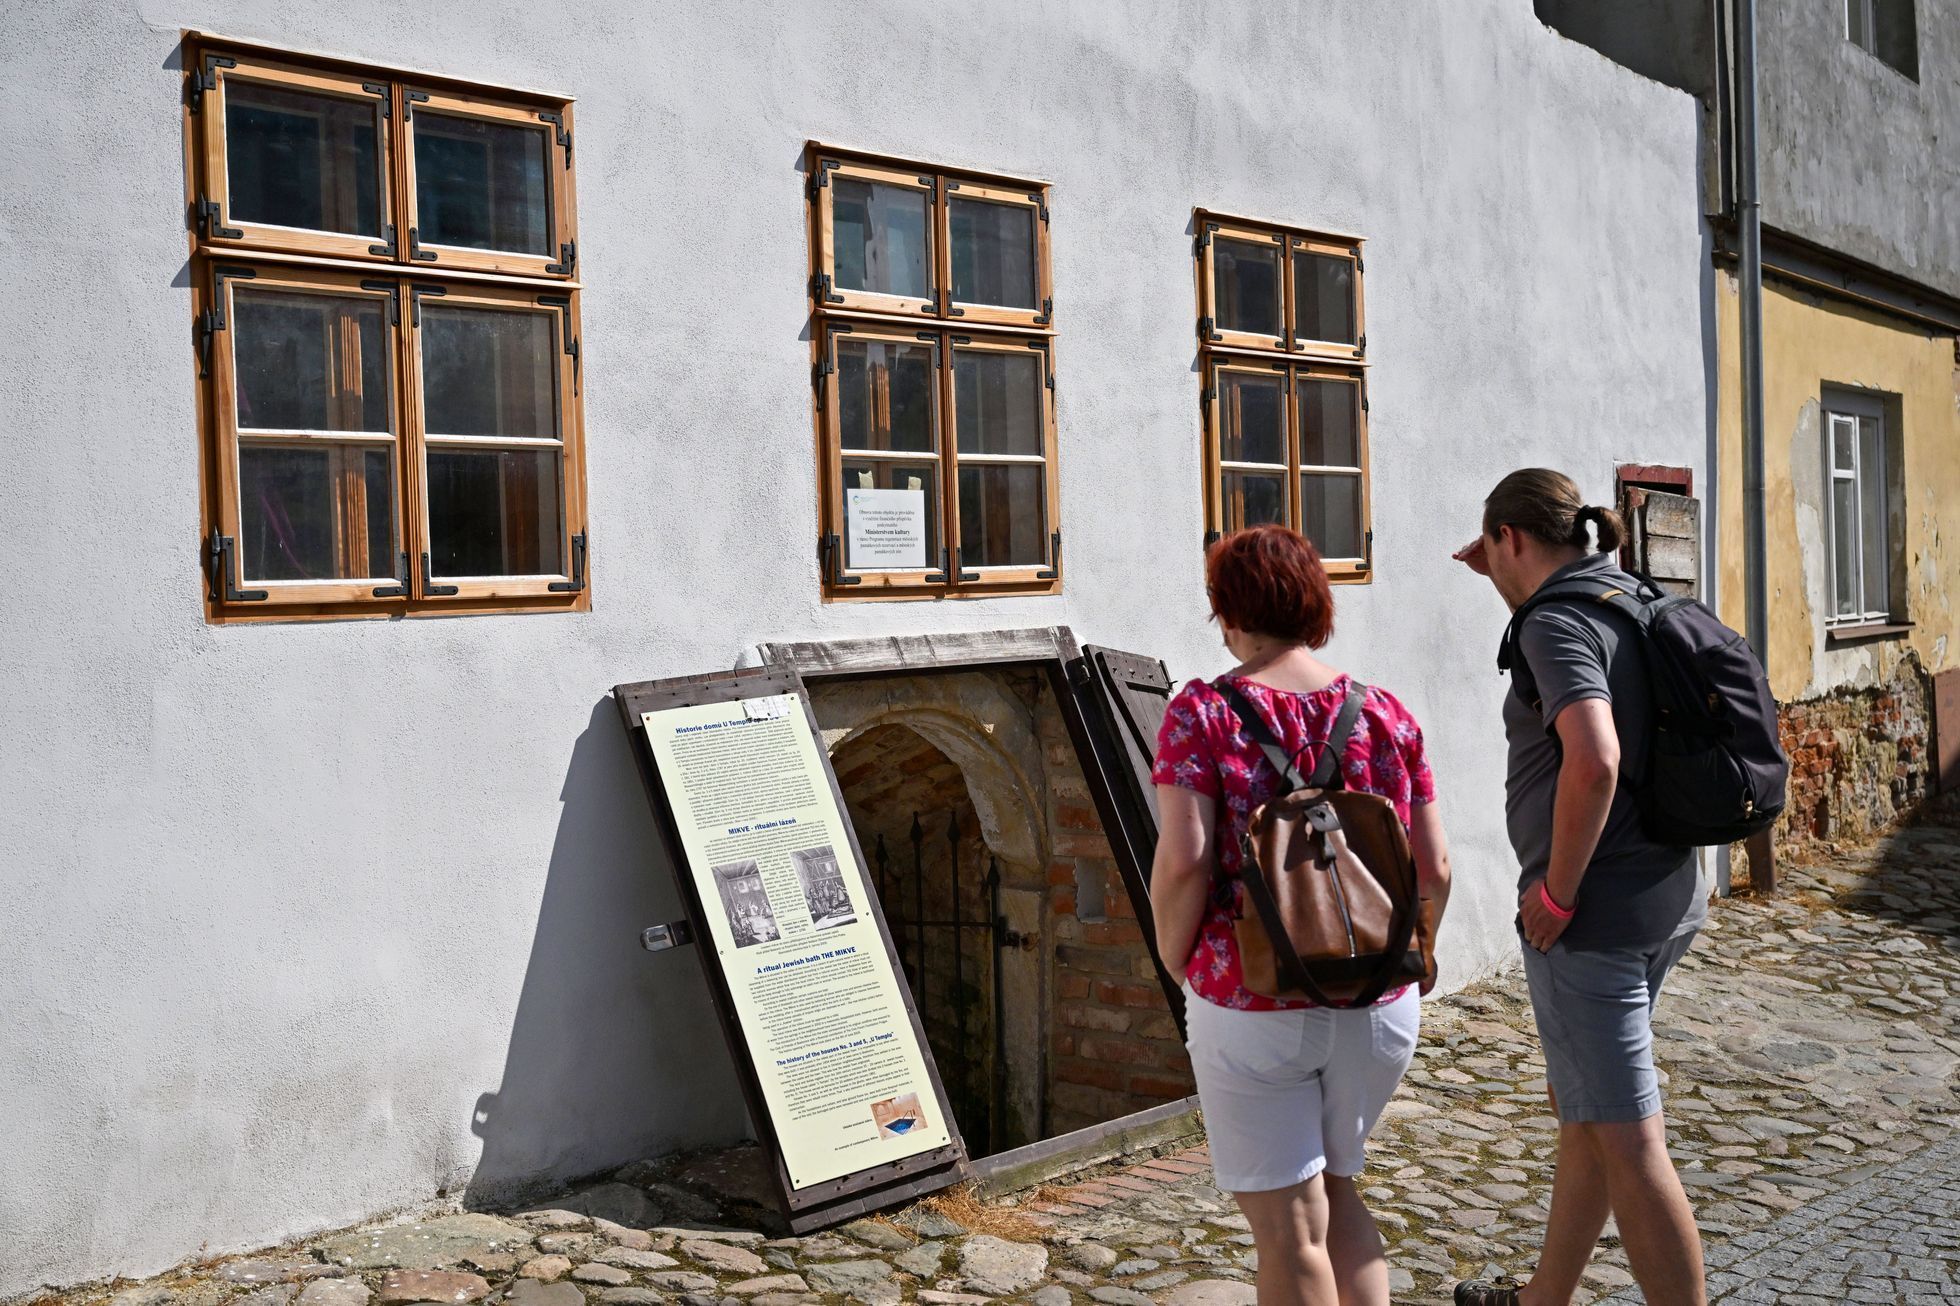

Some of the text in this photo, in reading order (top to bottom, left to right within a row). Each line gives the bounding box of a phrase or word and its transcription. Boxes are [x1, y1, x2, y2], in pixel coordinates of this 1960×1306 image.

[676, 725, 702, 734] Historie
[728, 826, 750, 835] MIKVE
[763, 964, 781, 973] ritual
[783, 958, 804, 968] Jewish
[805, 954, 821, 963] bath
[821, 950, 834, 959] THE
[835, 946, 857, 957] MIKVE
[786, 1055, 805, 1064] history
[821, 1047, 839, 1055] houses
